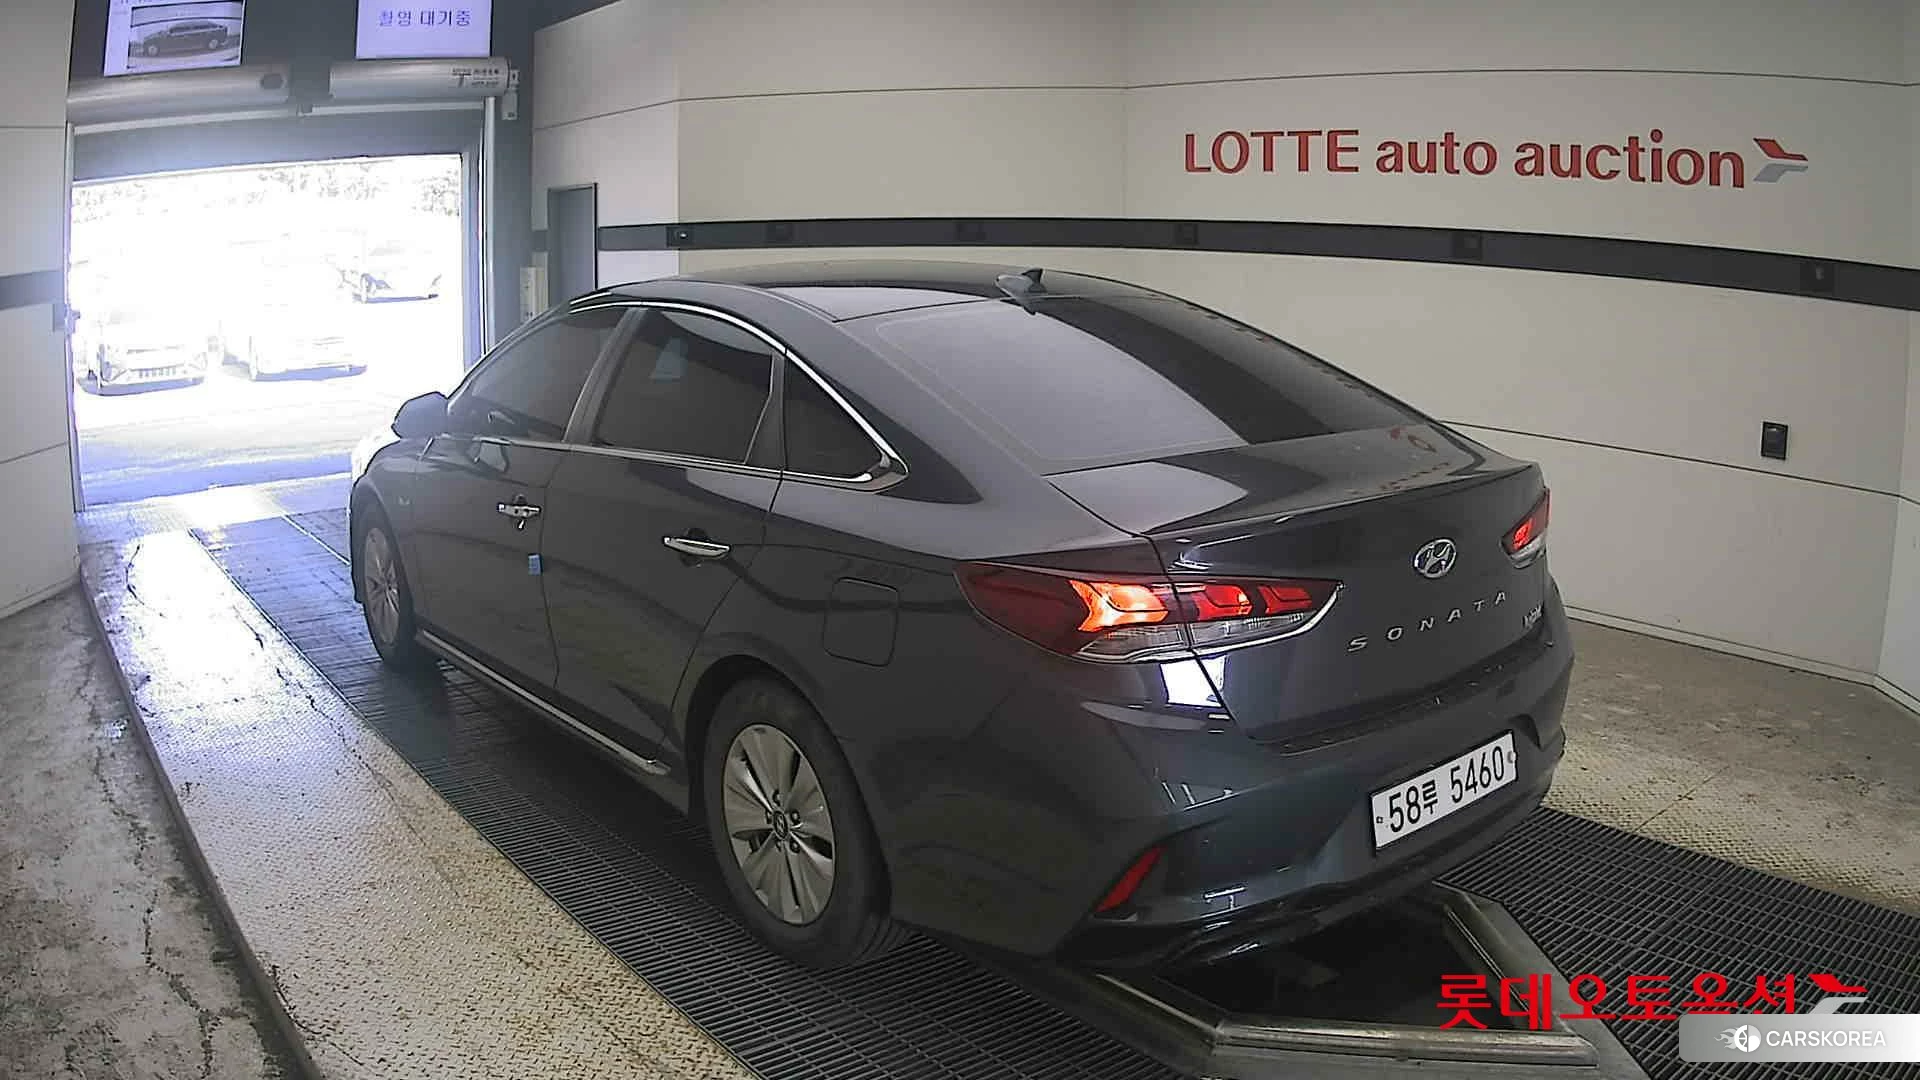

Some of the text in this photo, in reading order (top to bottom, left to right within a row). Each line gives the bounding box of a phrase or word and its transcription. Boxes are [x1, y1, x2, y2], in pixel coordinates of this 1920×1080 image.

[420, 10, 470, 27] 대기중
[1184, 128, 1745, 189] LOTTE auto auction
[1347, 591, 1506, 652] SONATA
[1388, 746, 1504, 833] 58루 5460
